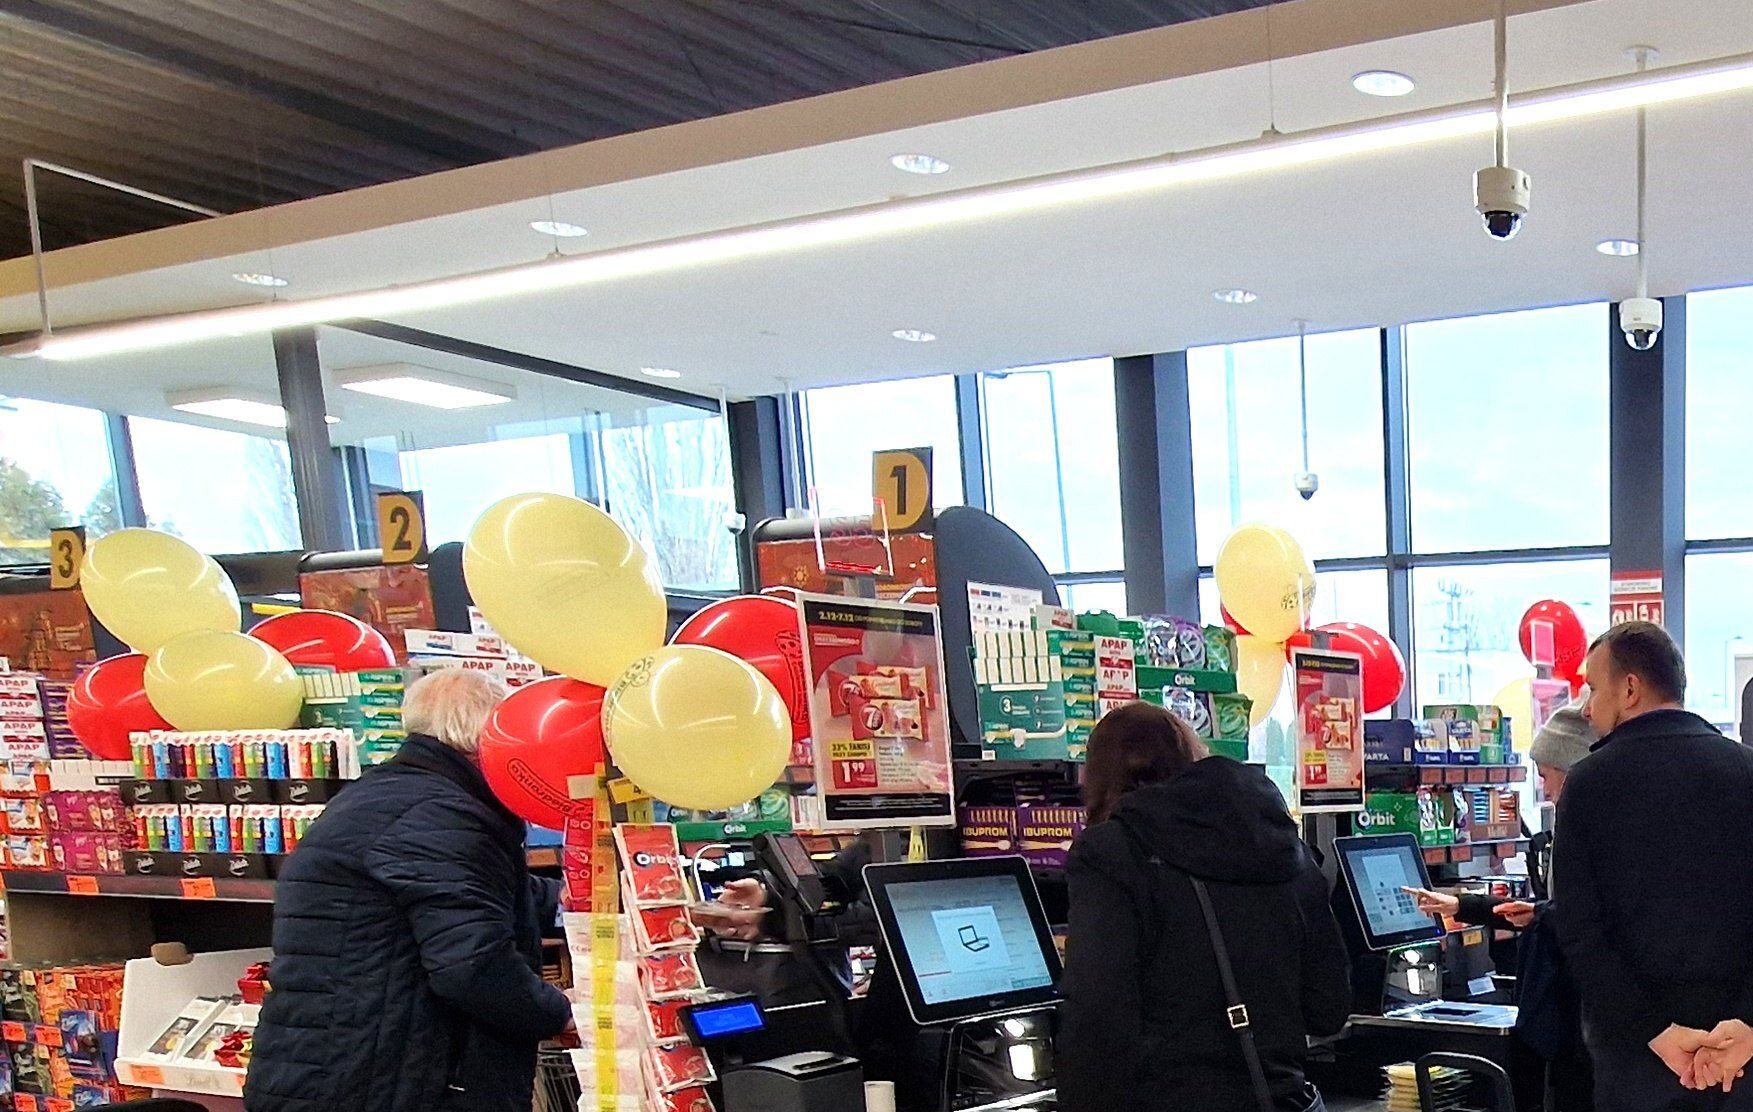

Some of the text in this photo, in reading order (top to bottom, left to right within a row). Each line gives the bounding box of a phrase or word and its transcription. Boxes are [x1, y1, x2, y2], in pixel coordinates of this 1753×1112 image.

[890, 465, 907, 516] 1
[390, 506, 412, 550] 2
[58, 539, 74, 578] 3
[1101, 638, 1127, 650] APAP
[462, 660, 493, 671] APAP
[505, 662, 536, 672] APAP
[1174, 675, 1196, 686] Orbit
[8, 743, 40, 751] APAP
[1363, 753, 1390, 761] VARTA
[1357, 811, 1396, 828] Orbit
[723, 823, 747, 835] Orbit
[963, 827, 1009, 837] IBUPROM
[1023, 827, 1074, 837] IBUPROM
